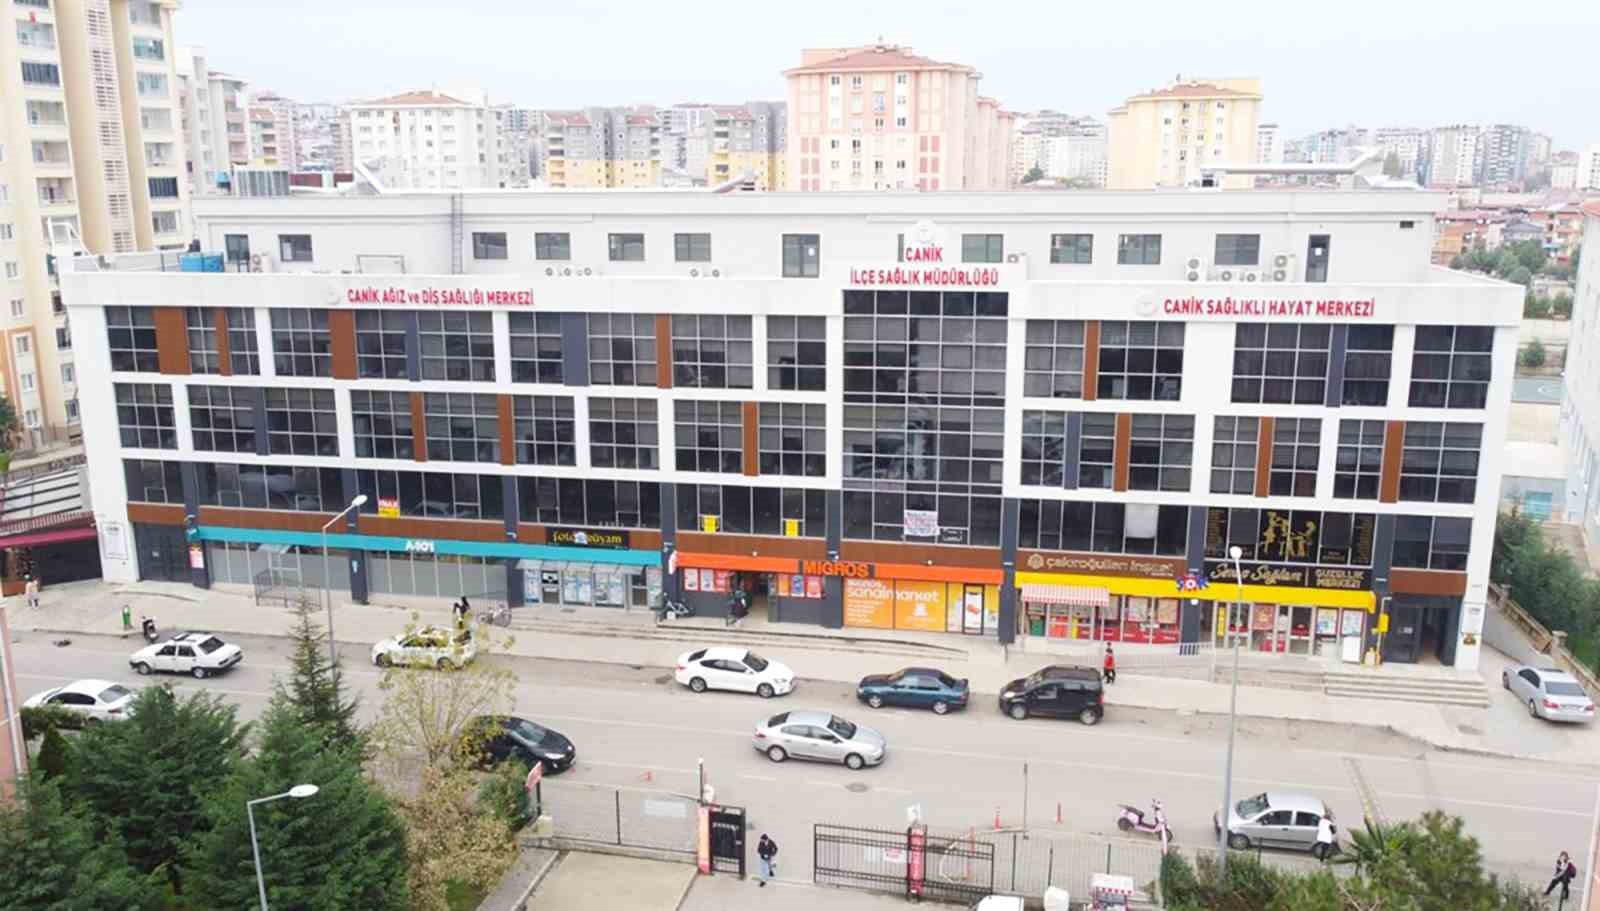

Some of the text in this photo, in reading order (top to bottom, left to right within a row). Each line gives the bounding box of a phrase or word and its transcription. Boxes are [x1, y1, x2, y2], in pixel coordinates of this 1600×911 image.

[905, 243, 943, 262] CANİK
[850, 266, 998, 287] İLÇE SAĞLIK MÜDÜRLÜĞÜ
[347, 287, 534, 306] CANİK AĞIZ ve DİŞ SAĞLIĞI MERKEZİ
[1164, 297, 1376, 318] CANİK SAĞLIKLI HAYAT MERKEZİ
[803, 560, 869, 577] MIGROS
